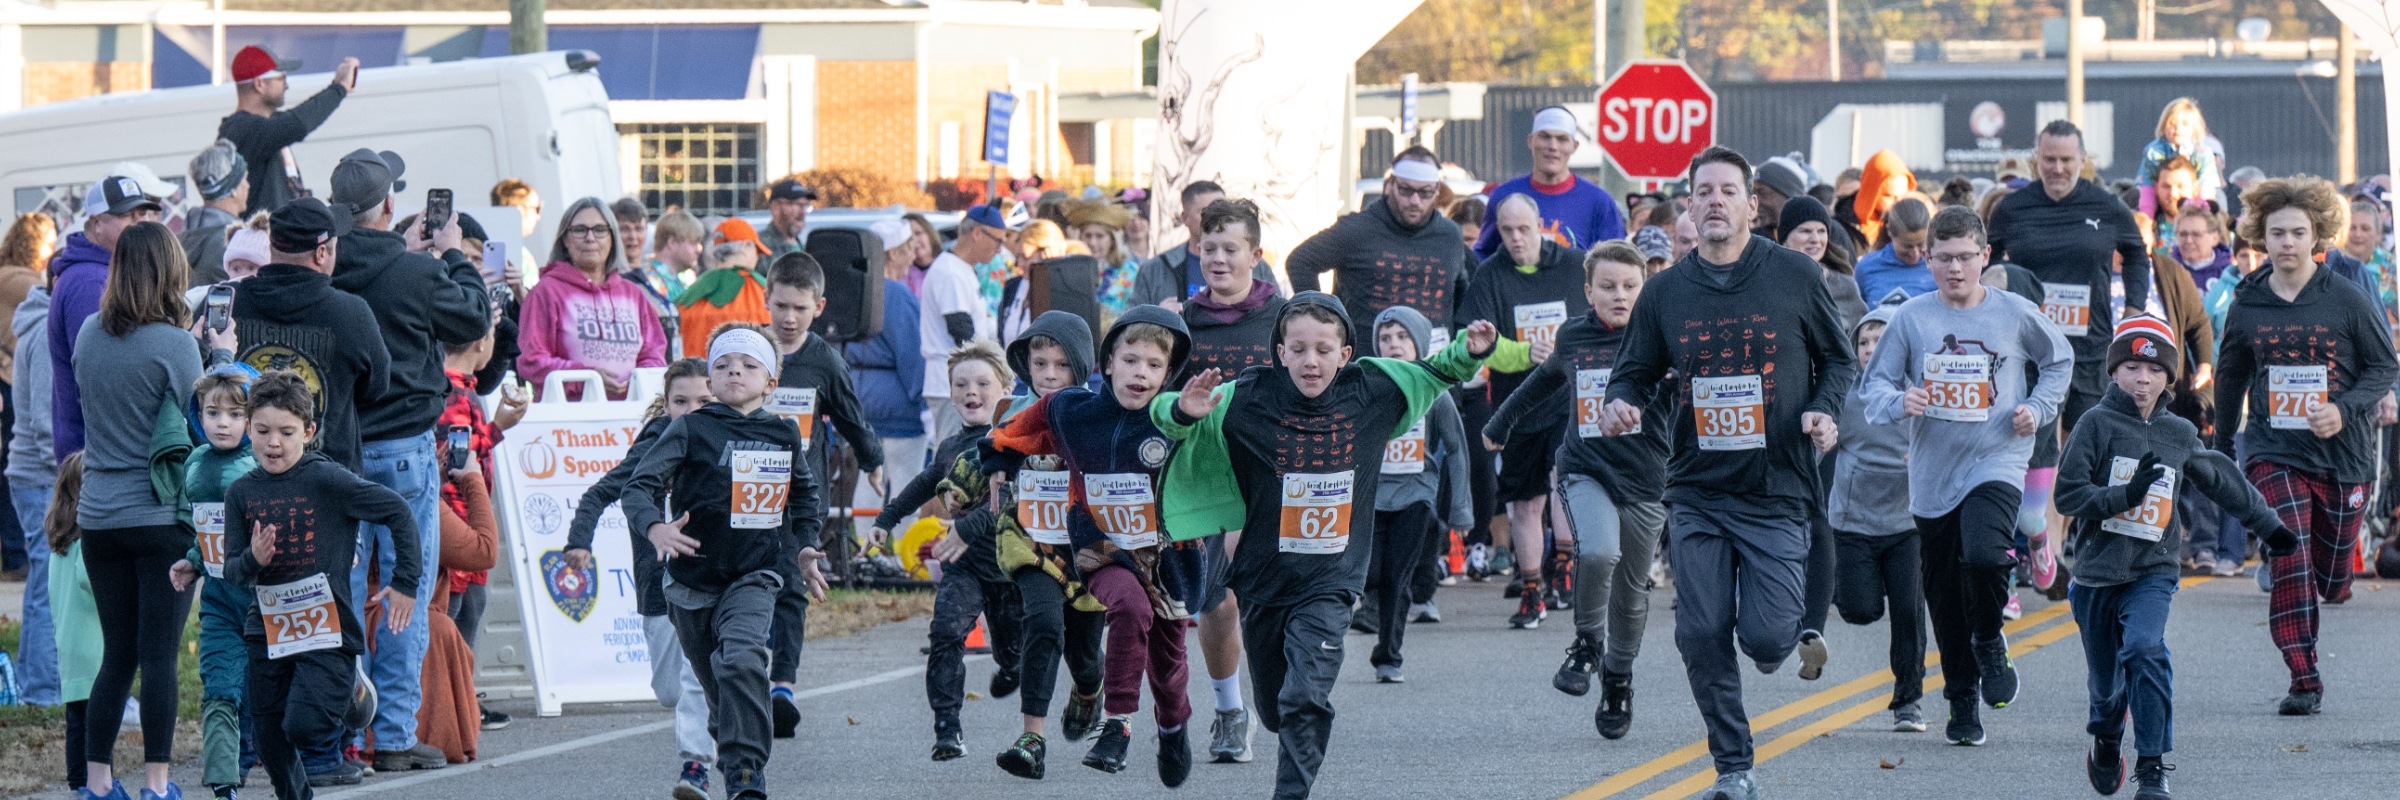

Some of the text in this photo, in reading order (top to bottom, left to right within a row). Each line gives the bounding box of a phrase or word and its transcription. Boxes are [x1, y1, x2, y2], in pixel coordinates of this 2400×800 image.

[1602, 97, 1708, 144] STOP
[2044, 304, 2080, 325] 601
[583, 319, 638, 342] OHIO
[1931, 382, 1980, 409] 536
[2276, 392, 2320, 417] 276
[1703, 406, 1756, 436] 395
[552, 428, 619, 448] Thank
[741, 483, 787, 513] 322
[1098, 506, 1147, 534] 105
[1300, 507, 1338, 539] 62
[272, 606, 332, 643] 252
